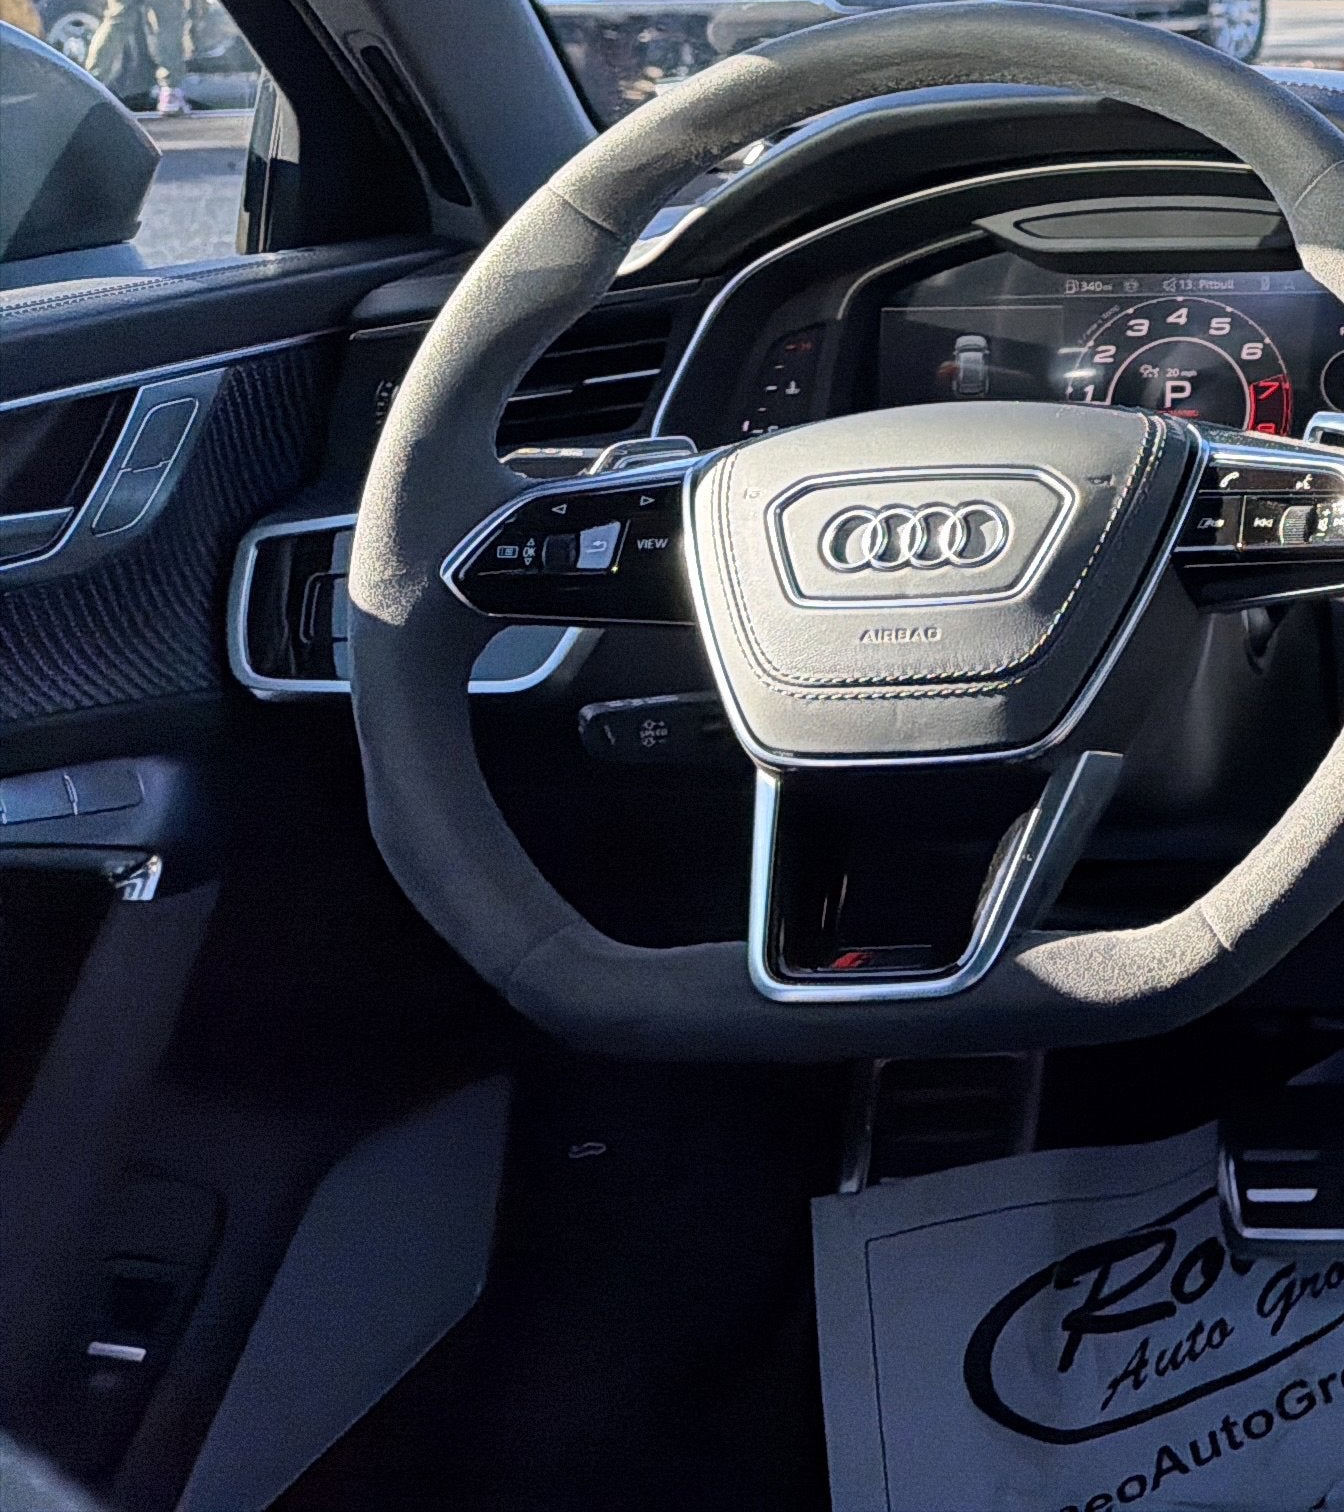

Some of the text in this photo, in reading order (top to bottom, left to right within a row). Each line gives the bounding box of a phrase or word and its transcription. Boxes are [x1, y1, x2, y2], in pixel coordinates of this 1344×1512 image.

[1166, 308, 1189, 326] 4
[1208, 317, 1232, 335] 5
[1125, 319, 1150, 337] 3
[1093, 345, 1117, 363] 2
[1240, 343, 1263, 361] 6
[1166, 368, 1180, 378] 20
[1084, 384, 1096, 403] 1
[1165, 380, 1192, 408] P
[1257, 382, 1281, 400] 7
[523, 546, 536, 557] OK
[637, 538, 668, 549] VIEW
[859, 626, 942, 644] AIRBAG
[1101, 1316, 1235, 1412] Auto
